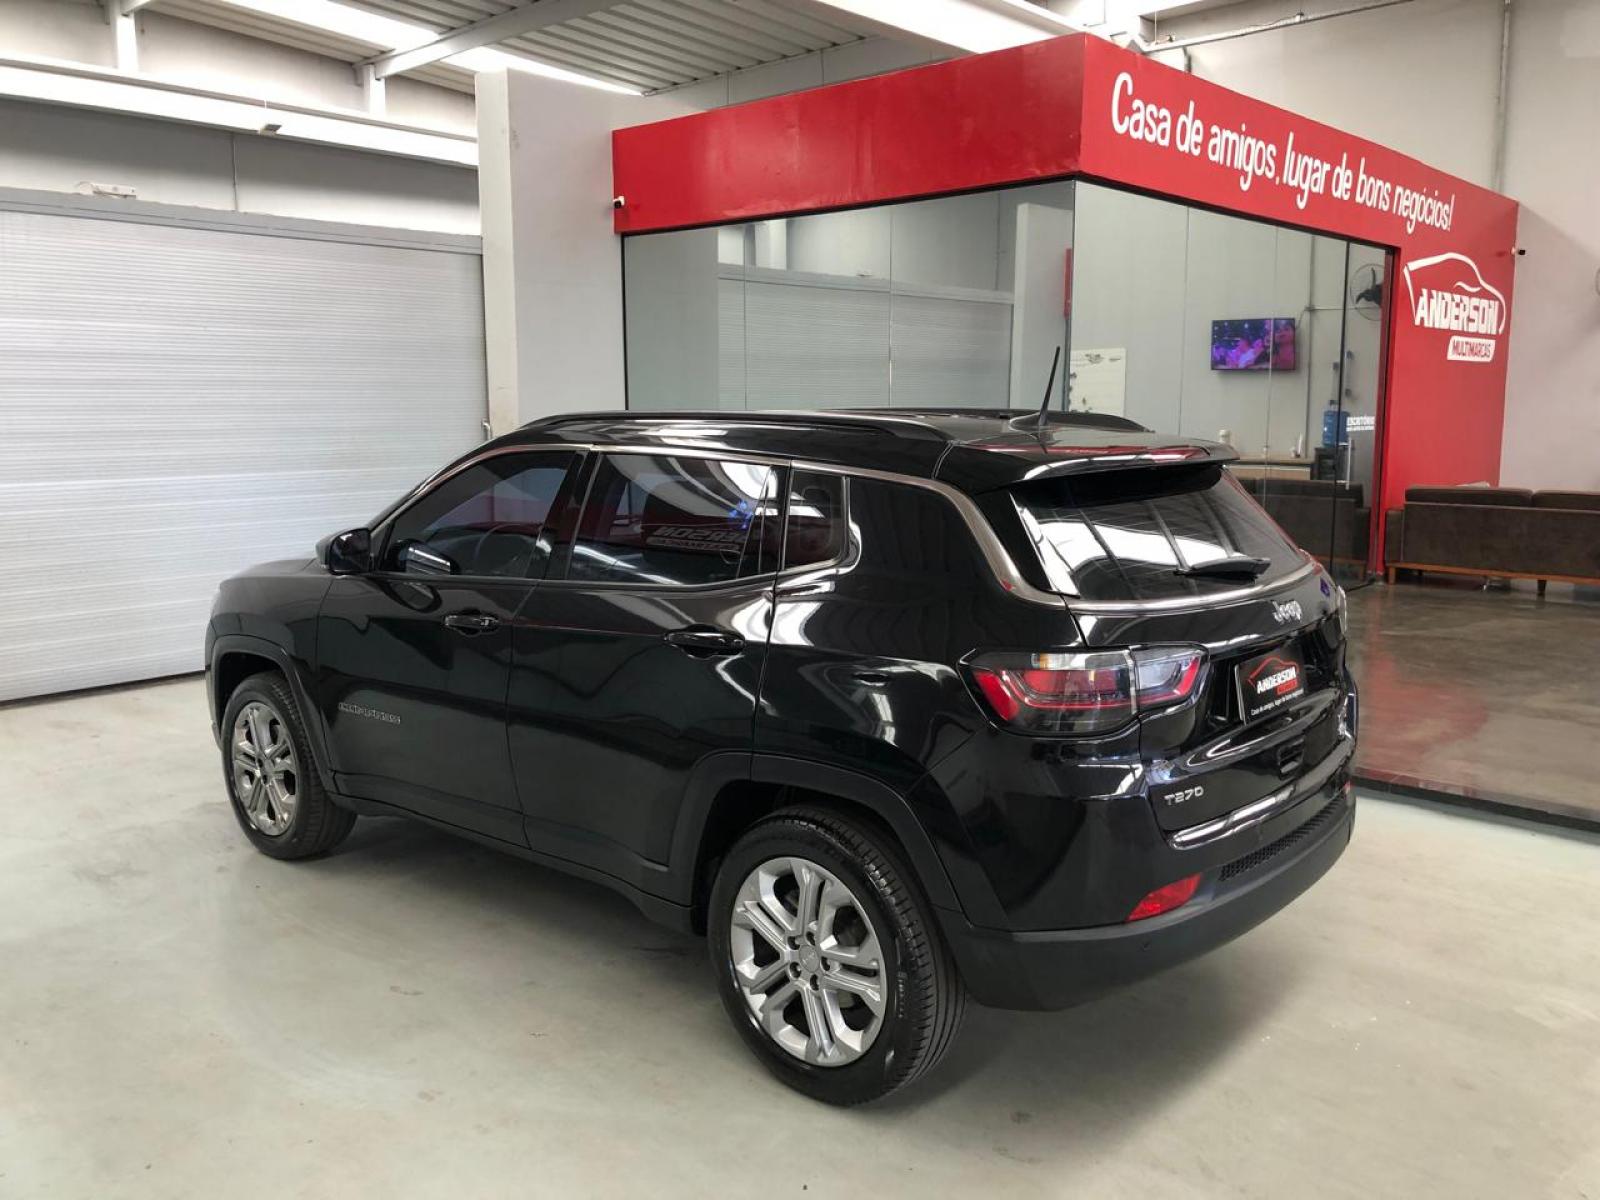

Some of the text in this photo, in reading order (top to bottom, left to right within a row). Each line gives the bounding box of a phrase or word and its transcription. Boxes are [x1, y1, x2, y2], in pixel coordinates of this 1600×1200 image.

[1111, 71, 1456, 235] Casa de amigos, lugar de bons negócios!
[1414, 287, 1500, 335] ANDERSON
[1256, 666, 1297, 695] ANDERSON
[1163, 785, 1205, 806] T270
